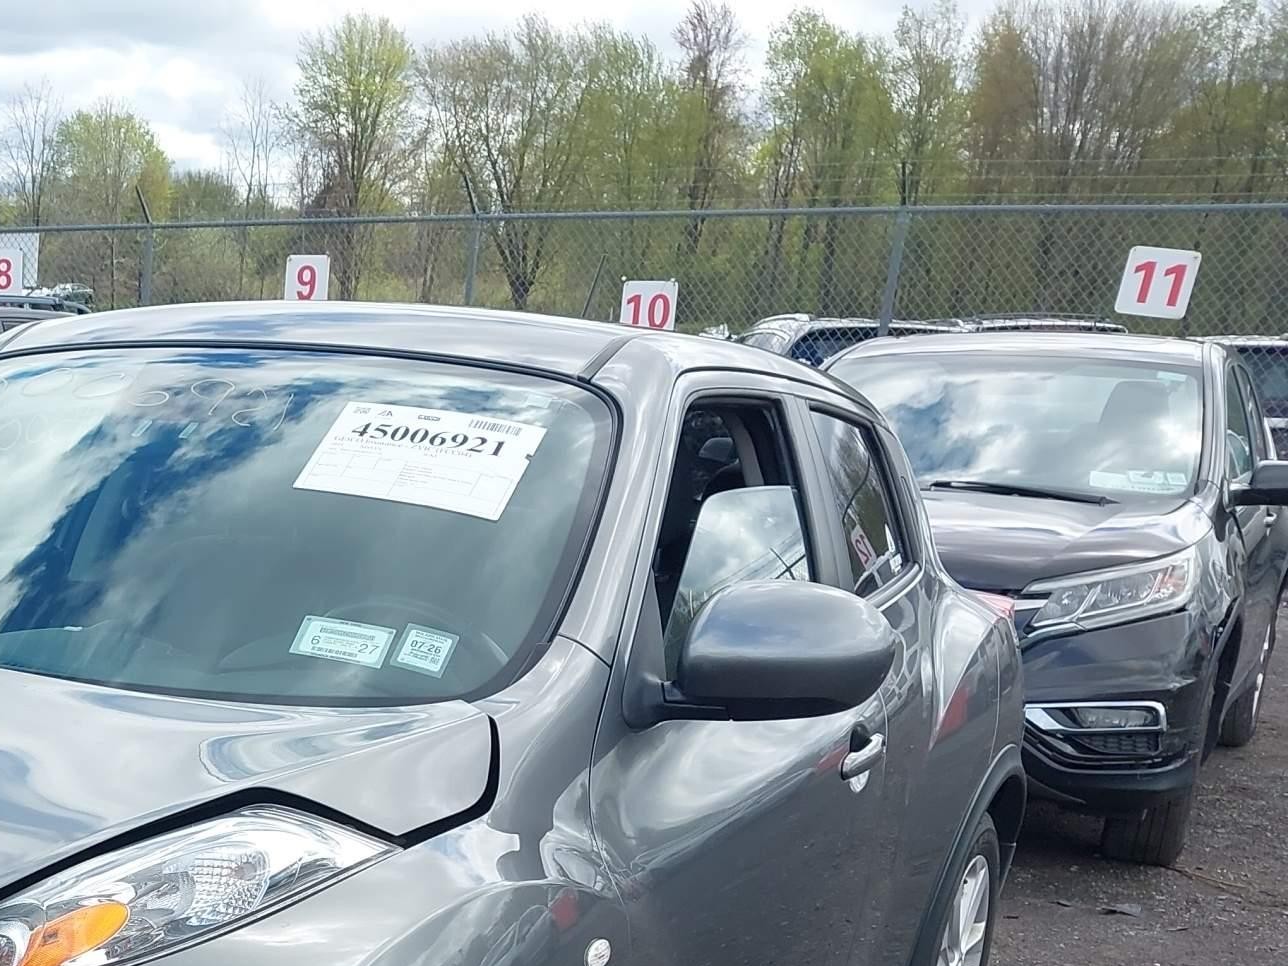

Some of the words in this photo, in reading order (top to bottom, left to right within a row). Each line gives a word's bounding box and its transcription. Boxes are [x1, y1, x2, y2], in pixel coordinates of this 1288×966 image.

[296, 265, 317, 301] 9
[1133, 261, 1188, 307] 11
[626, 293, 671, 329] 10
[351, 422, 506, 457] 45006921
[311, 635, 321, 645] 6
[358, 643, 380, 655] 27
